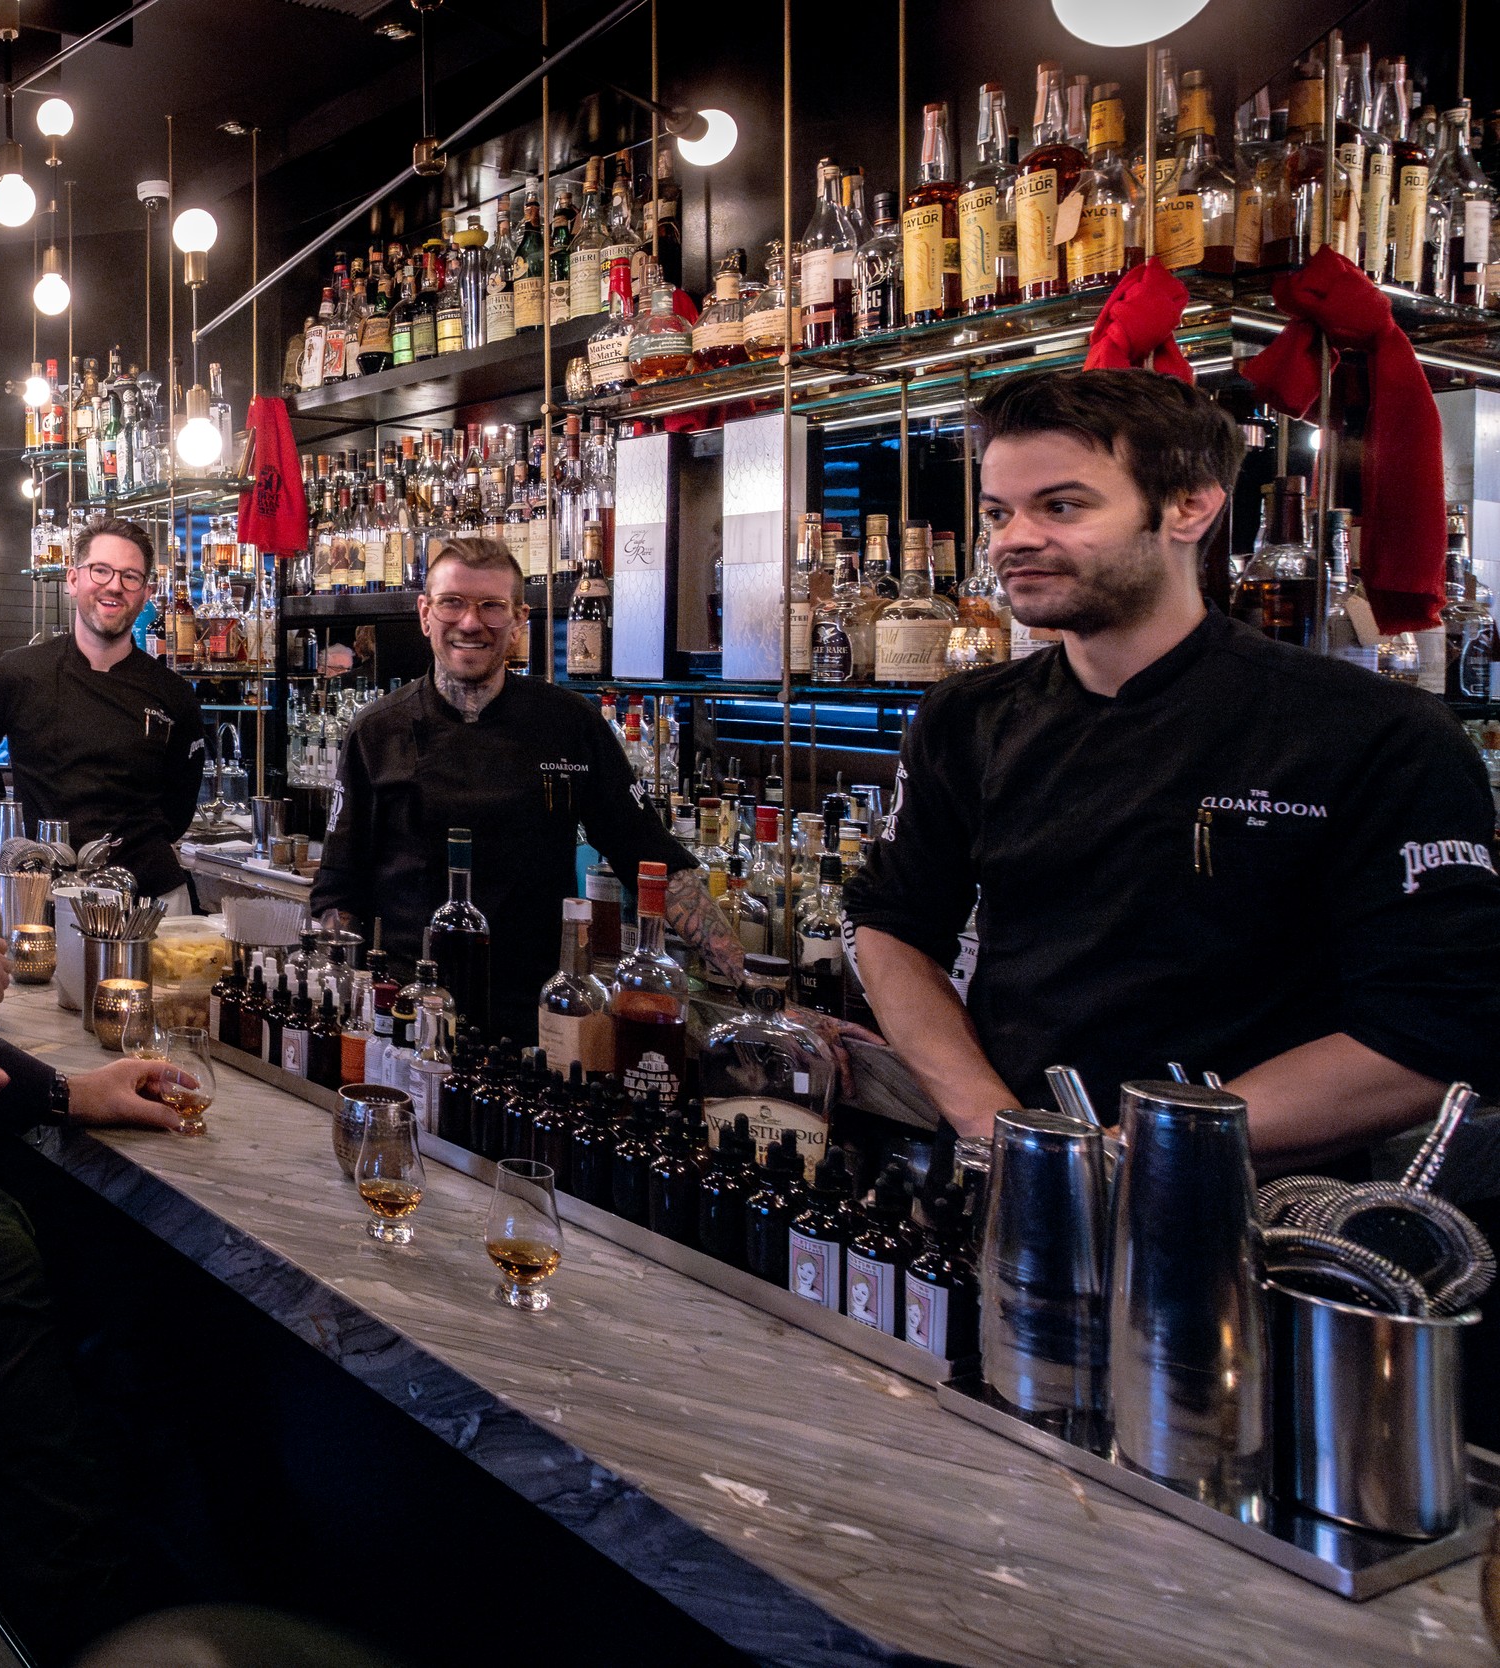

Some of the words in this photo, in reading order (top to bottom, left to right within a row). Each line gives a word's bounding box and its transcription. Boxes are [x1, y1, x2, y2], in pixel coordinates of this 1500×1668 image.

[1016, 179, 1053, 198] TAYLOR
[959, 196, 993, 214] TAYLOR
[1081, 207, 1118, 219] AYLOR
[904, 213, 940, 229] TAYLOR
[589, 340, 622, 354] Maker's
[597, 347, 621, 361] Mark
[827, 646, 848, 655] RARE
[540, 762, 589, 773] CLOAKROOM
[1250, 788, 1270, 798] THE
[1201, 796, 1328, 818] CLOAKROOM
[1246, 816, 1268, 827] Bar
